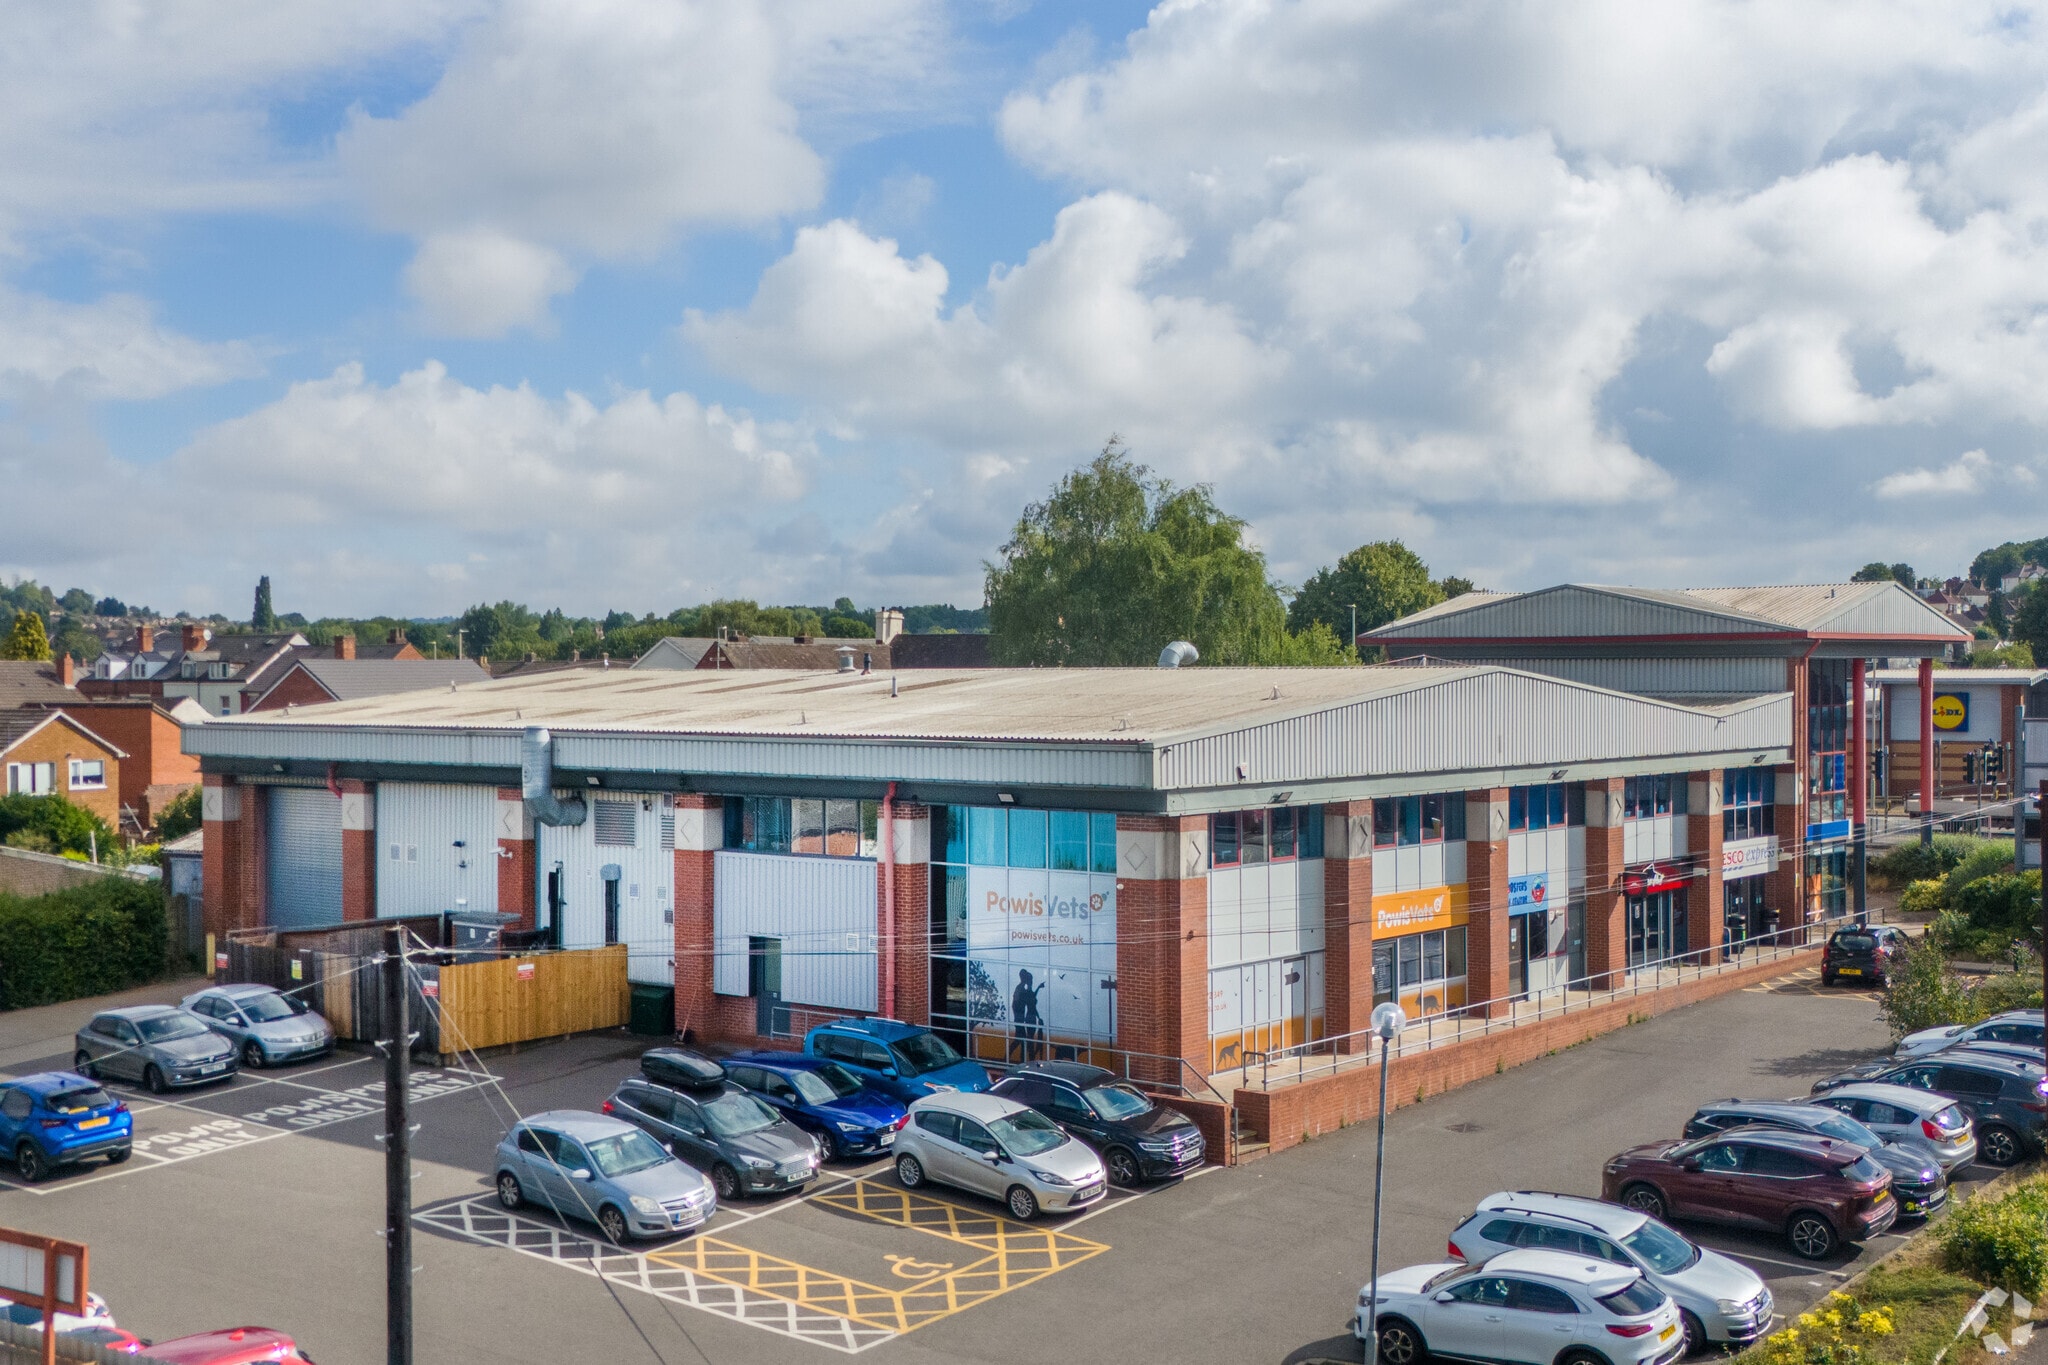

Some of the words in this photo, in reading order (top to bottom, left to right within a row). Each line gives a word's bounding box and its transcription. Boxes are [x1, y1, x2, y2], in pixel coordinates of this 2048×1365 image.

[1745, 845, 1775, 865] express
[1011, 930, 1084, 945] powisvets.co.uk
[242, 1093, 350, 1122] POWIS
[286, 1101, 376, 1126] ONLY
[132, 1119, 243, 1150] POWIS
[166, 1130, 259, 1155] ONLY
